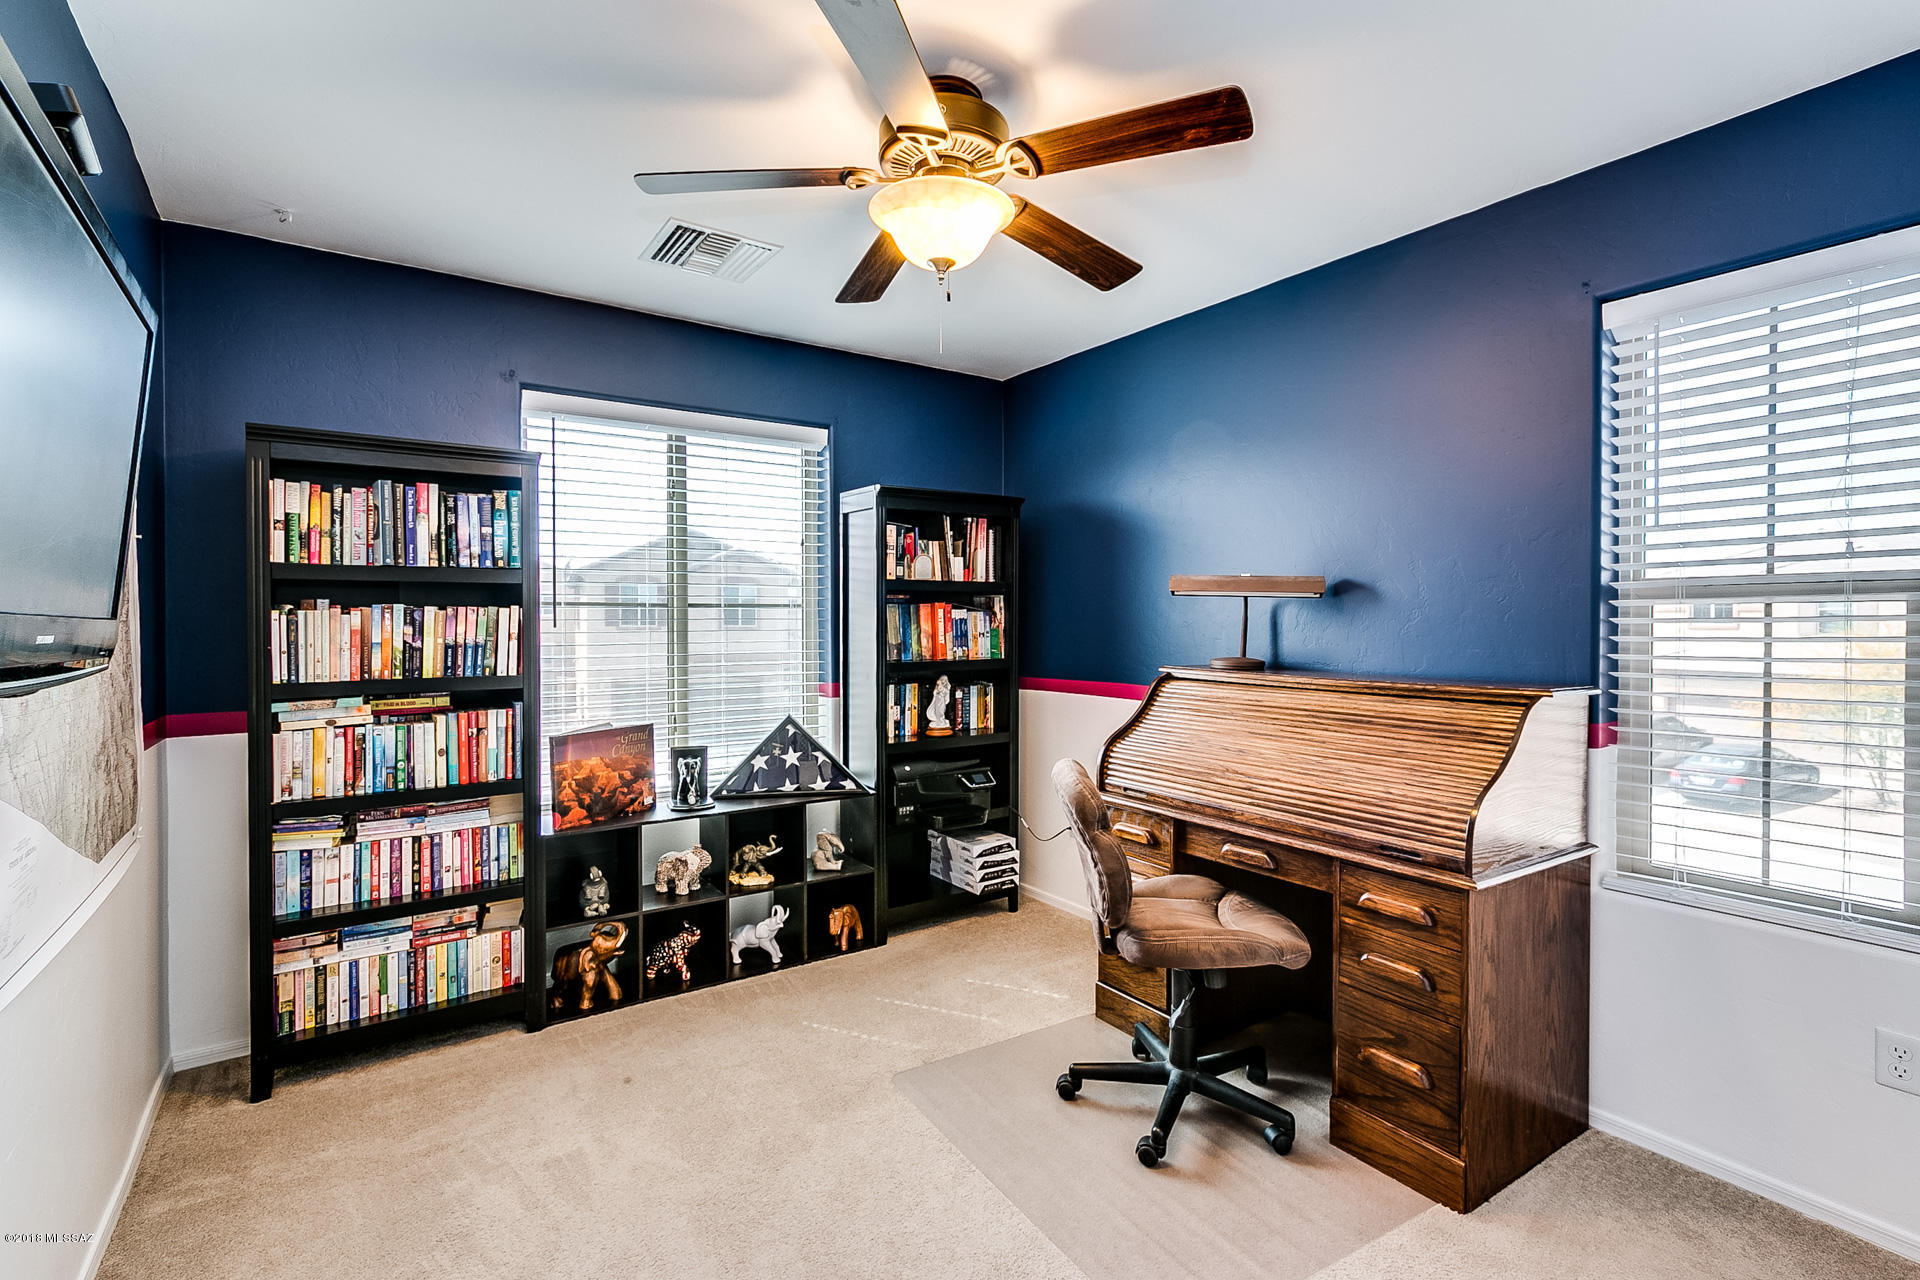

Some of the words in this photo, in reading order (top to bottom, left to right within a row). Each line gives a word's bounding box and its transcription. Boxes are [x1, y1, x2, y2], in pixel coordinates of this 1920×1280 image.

[288, 514, 297, 555] QUENTINS
[616, 726, 650, 744] Grand
[612, 743, 646, 757] Canyon
